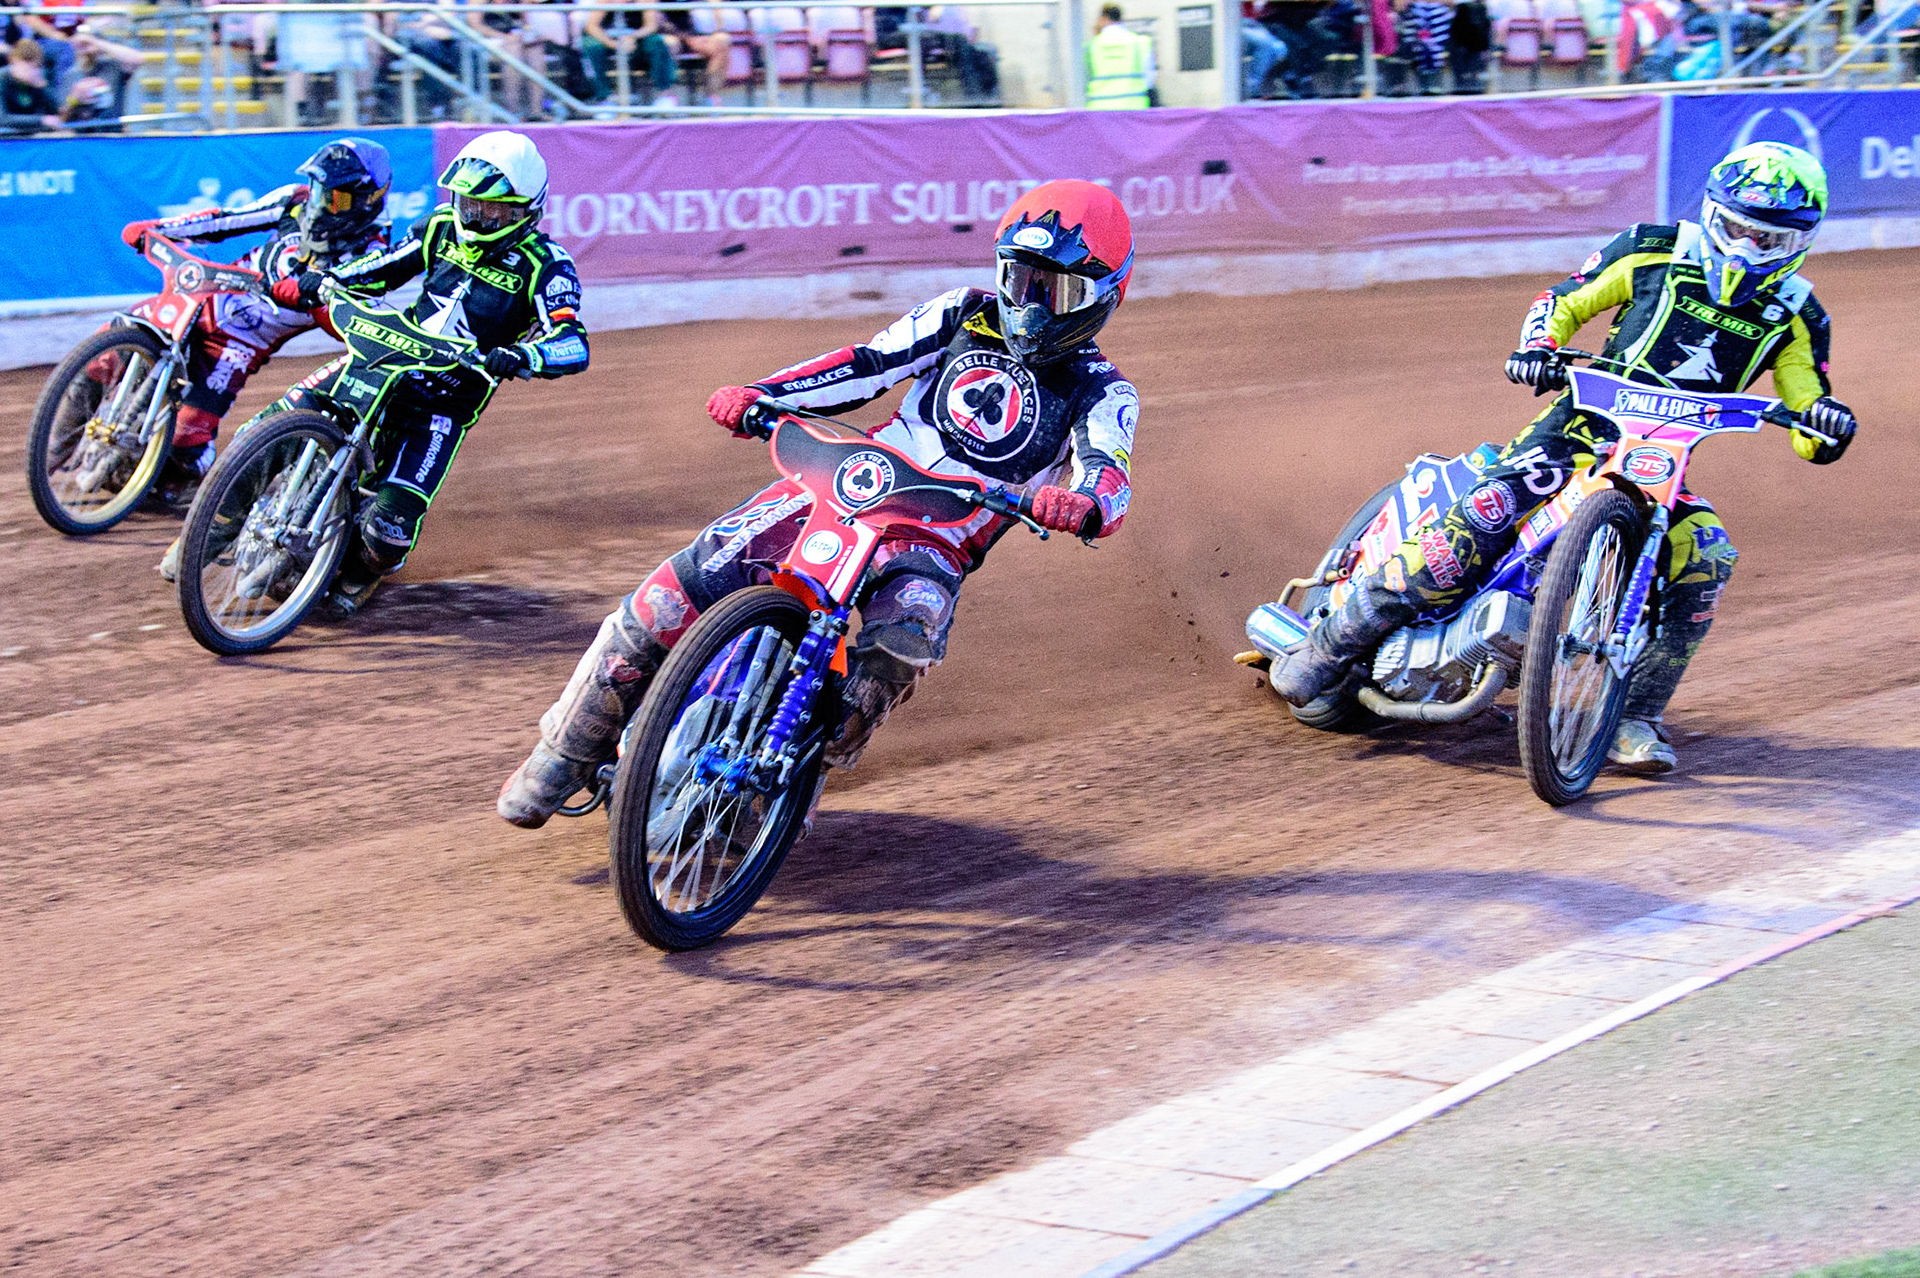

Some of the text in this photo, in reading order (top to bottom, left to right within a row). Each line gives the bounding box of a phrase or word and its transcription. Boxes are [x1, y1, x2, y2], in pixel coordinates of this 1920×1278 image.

[16, 169, 76, 195] MOT
[540, 183, 880, 239] HORNEYCROFT
[502, 252, 521, 267] 3
[1686, 301, 1758, 337] TRU MIX
[1761, 304, 1784, 321] 6
[352, 319, 422, 356] TRU MIX
[955, 355, 1034, 424] BELLE VUE ACES
[415, 430, 444, 483] silkolene
[1629, 457, 1666, 473] STS
[1475, 488, 1504, 522] STS
[701, 490, 813, 573] WESSEX MARINE
[1430, 528, 1464, 578] WATT
[903, 589, 938, 603] GM
